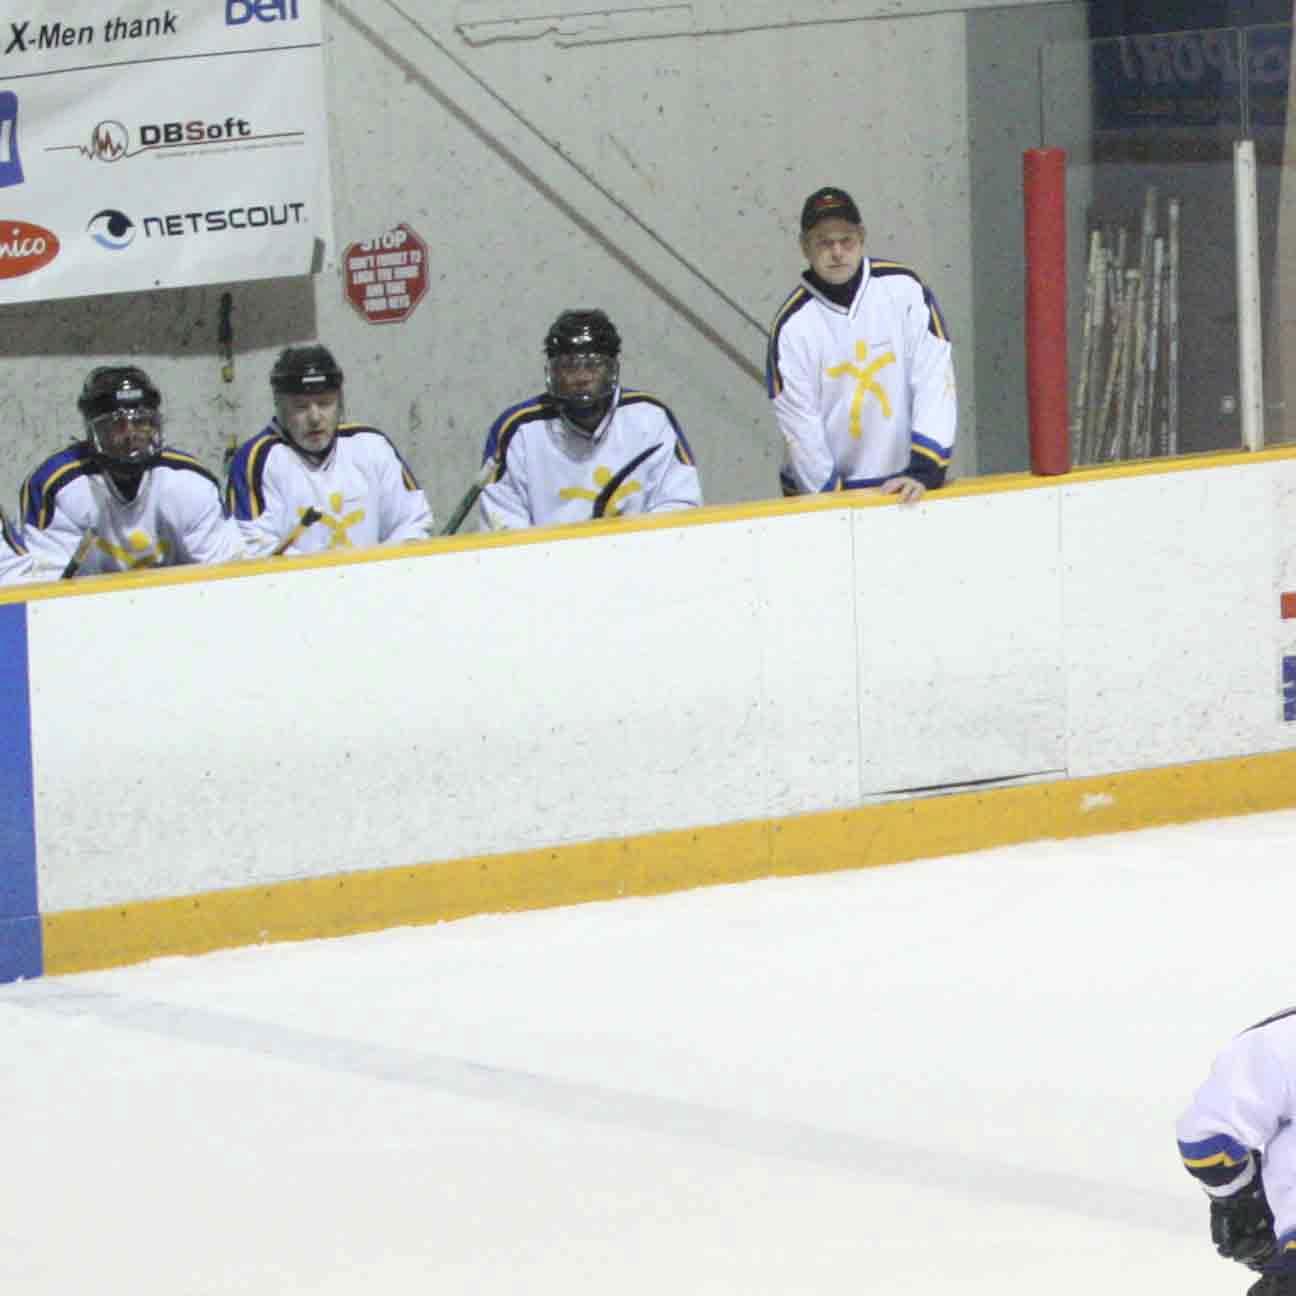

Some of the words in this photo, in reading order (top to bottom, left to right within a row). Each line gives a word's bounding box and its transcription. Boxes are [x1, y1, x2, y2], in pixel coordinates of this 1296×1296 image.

[4, 21, 94, 54] X-Men
[104, 10, 178, 42] thank
[139, 117, 251, 147] DBSoft
